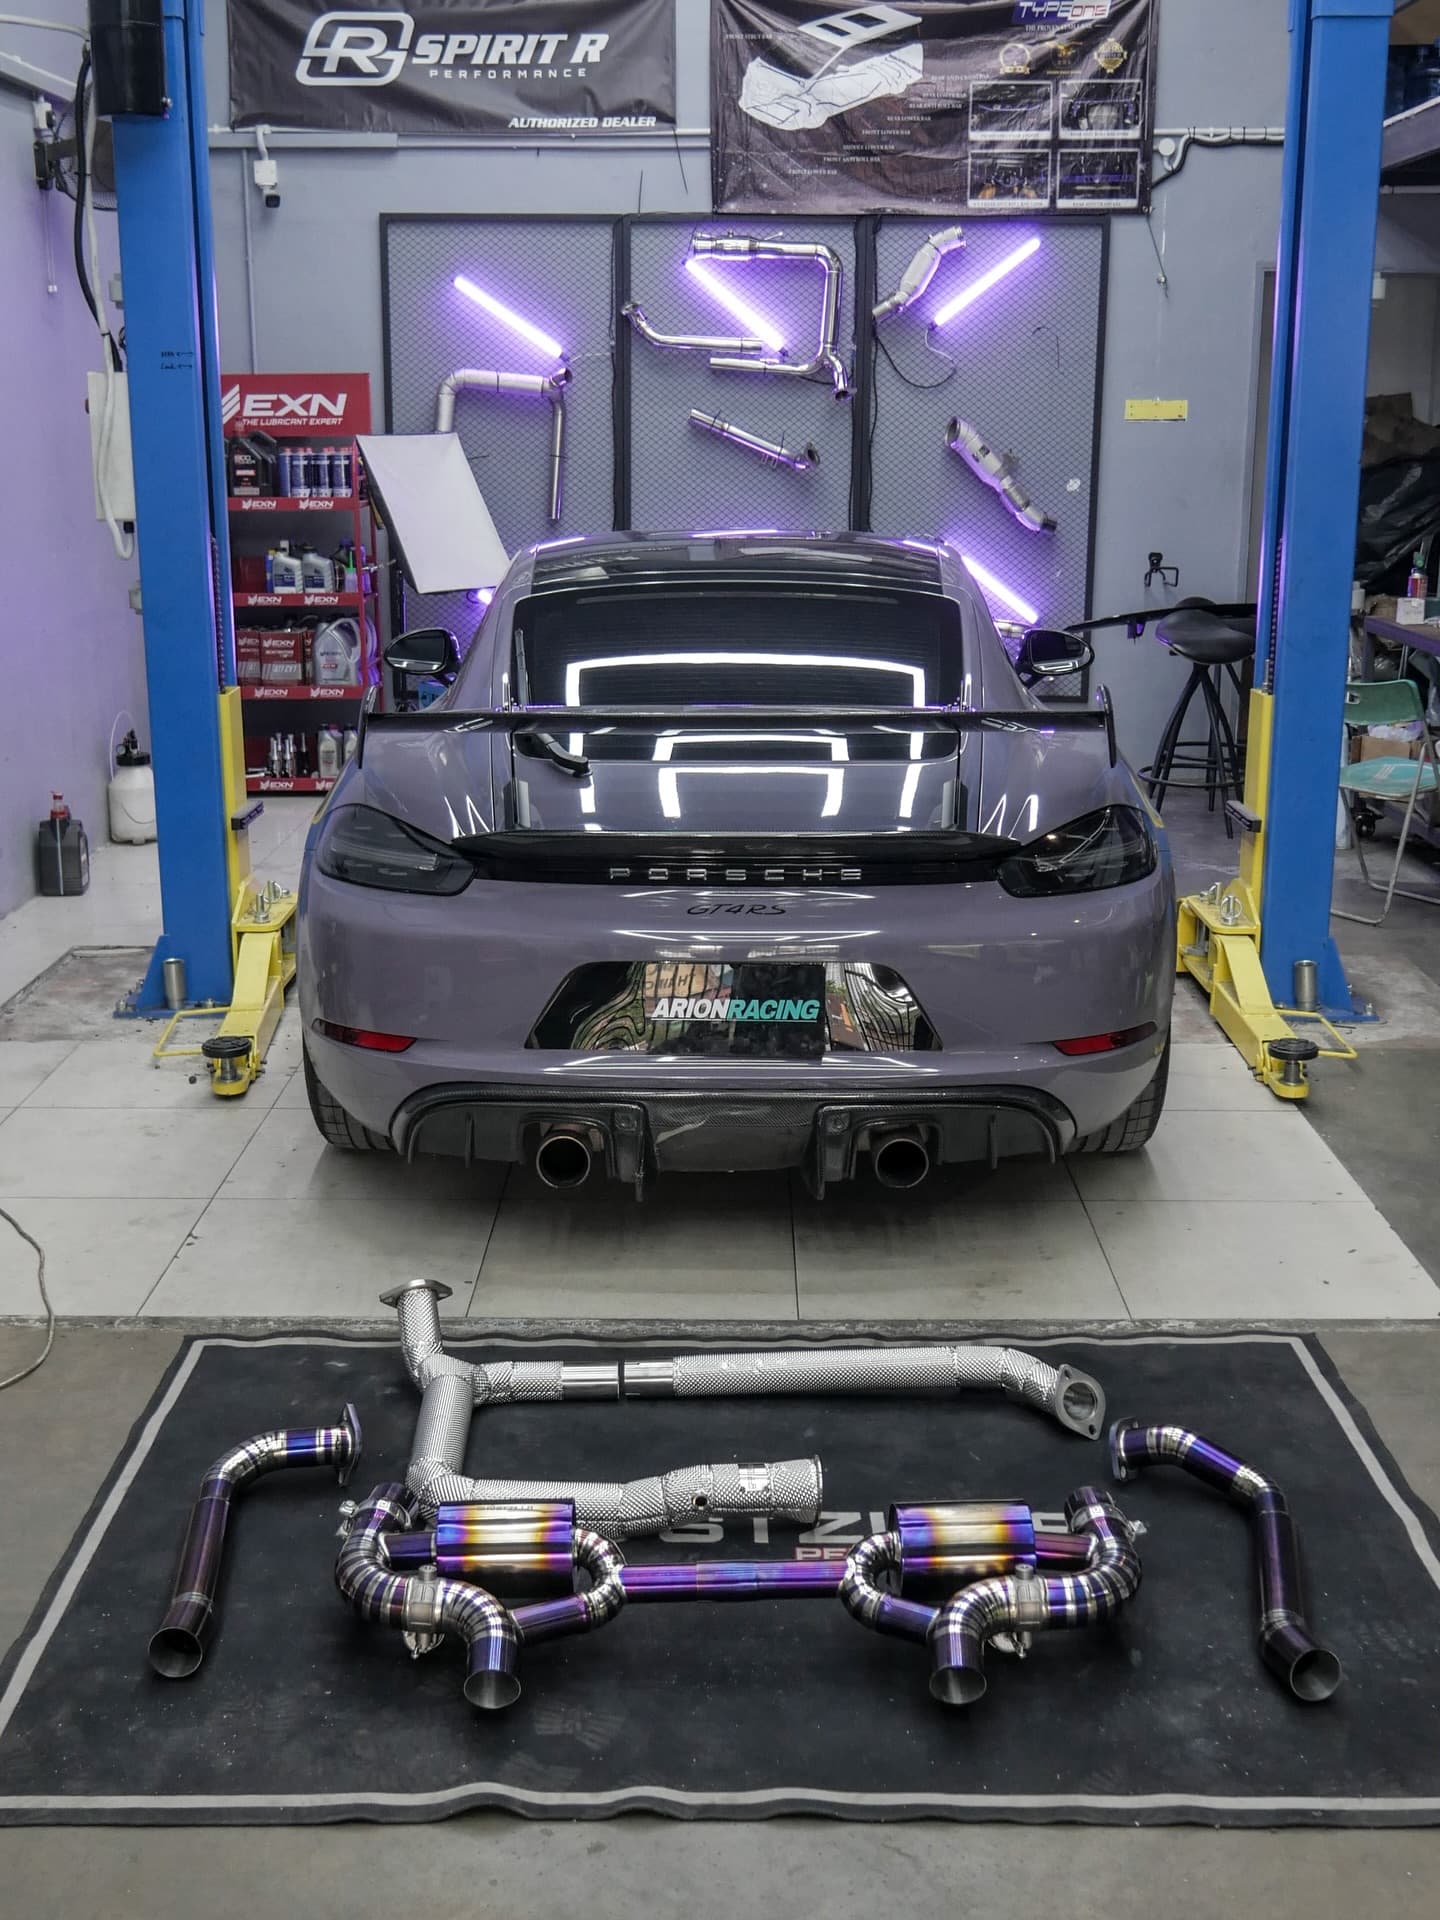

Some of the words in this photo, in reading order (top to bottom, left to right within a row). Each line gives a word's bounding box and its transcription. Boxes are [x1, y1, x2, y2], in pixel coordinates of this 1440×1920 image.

[412, 33, 569, 65] SPIRIT
[570, 33, 610, 63] R
[429, 68, 588, 79] PERFORMANCE
[508, 117, 598, 129] AUTHORIZED
[601, 116, 657, 127] DEALER
[242, 393, 347, 417] EXN
[243, 418, 258, 426] THE
[260, 418, 307, 426] LUBRICANT
[309, 418, 343, 426] EXPERT
[609, 867, 863, 882] PORSCHE
[651, 998, 821, 1022] ARIONRACING
